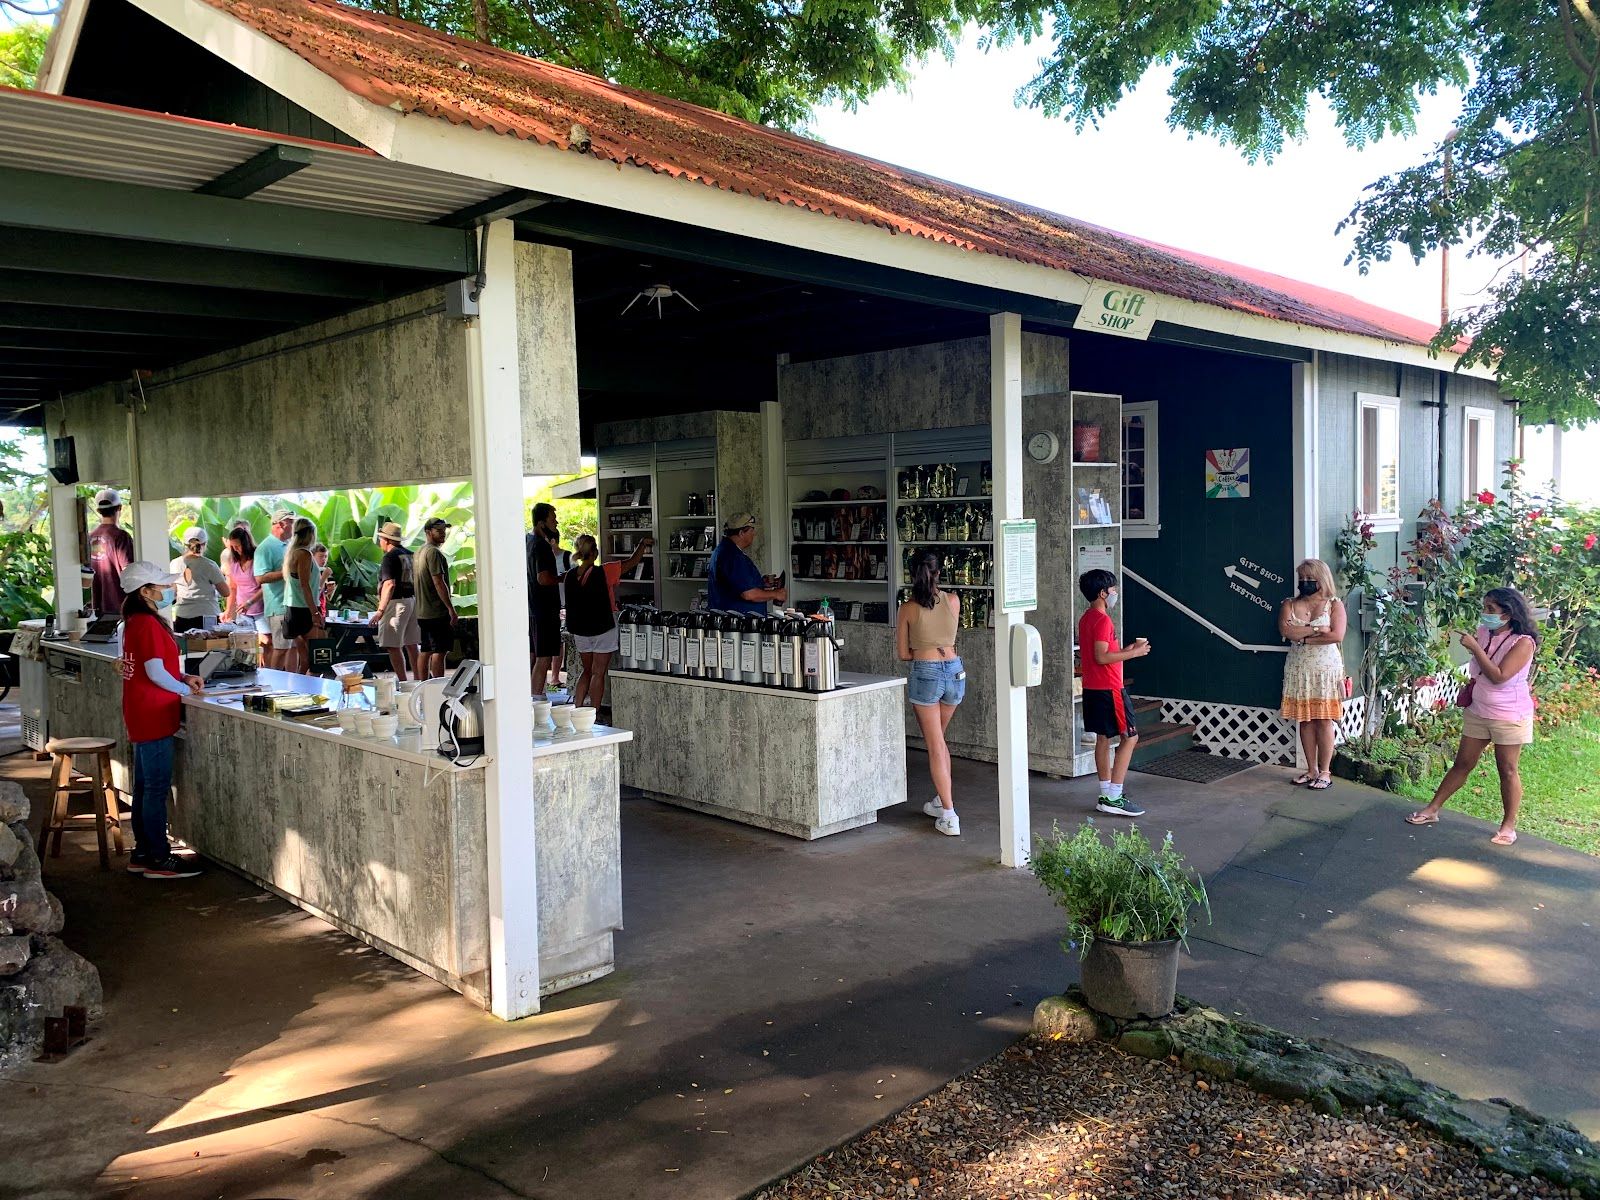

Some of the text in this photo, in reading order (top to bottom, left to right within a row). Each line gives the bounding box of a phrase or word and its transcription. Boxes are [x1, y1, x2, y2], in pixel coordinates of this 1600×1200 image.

[1103, 290, 1145, 316] Gift
[1098, 313, 1135, 330] SHOP
[1239, 556, 1285, 584] GIFT SHOP
[1229, 581, 1273, 612] RESTROOM
